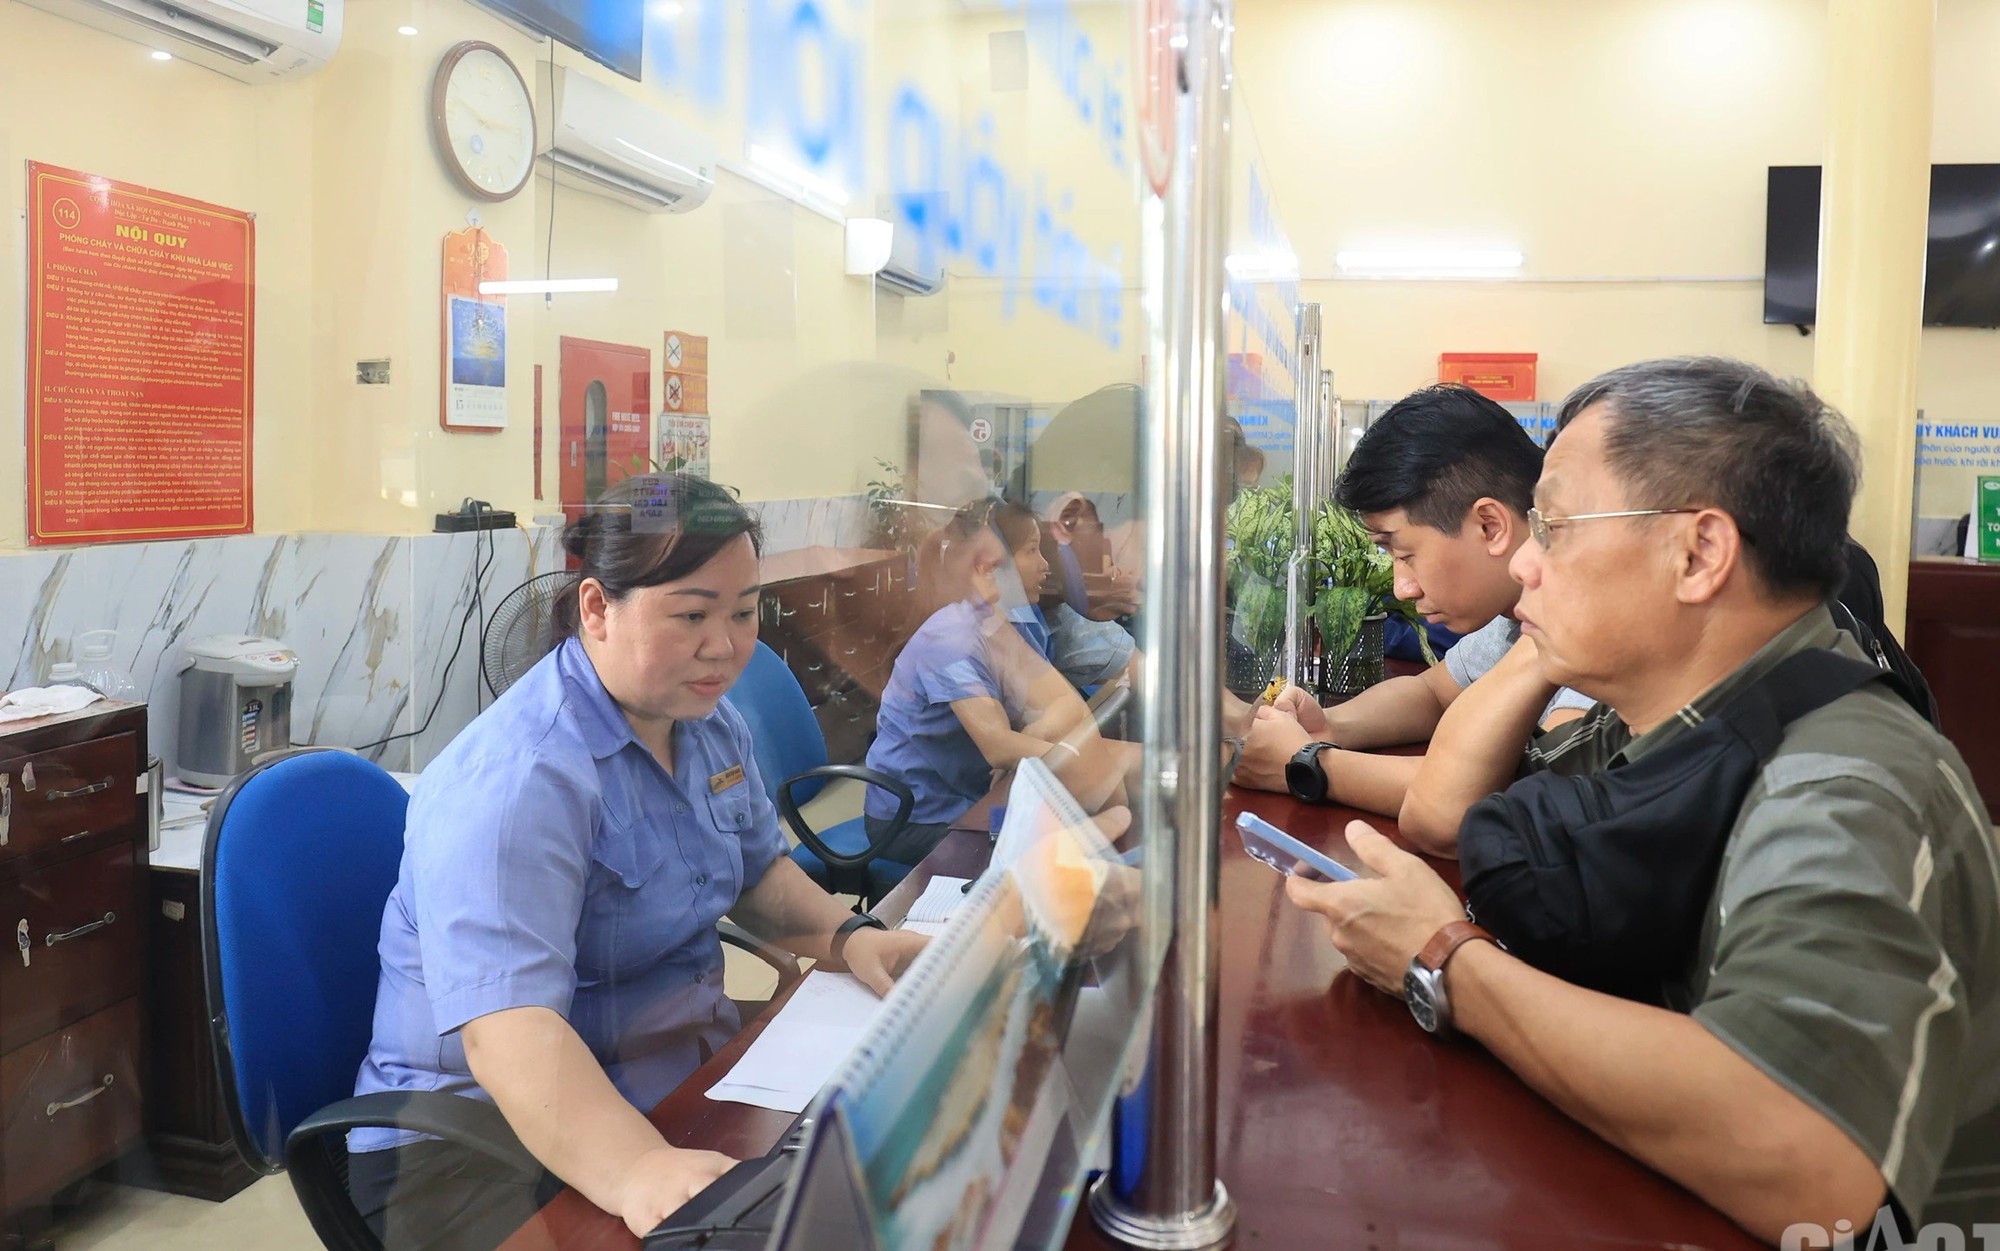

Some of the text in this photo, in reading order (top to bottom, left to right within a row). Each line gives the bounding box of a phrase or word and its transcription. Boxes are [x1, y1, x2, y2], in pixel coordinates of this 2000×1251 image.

[58, 207, 76, 220] 114
[116, 222, 187, 250] NỘI QUY
[59, 231, 234, 272] PHÒNG CHÁY VÀ CHỮA CHÁY KHU NHÀ LÀM VIỆC
[1936, 424, 1978, 438] KHÁCH
[1982, 426, 2000, 438] VU
[1964, 445, 1990, 455] người
